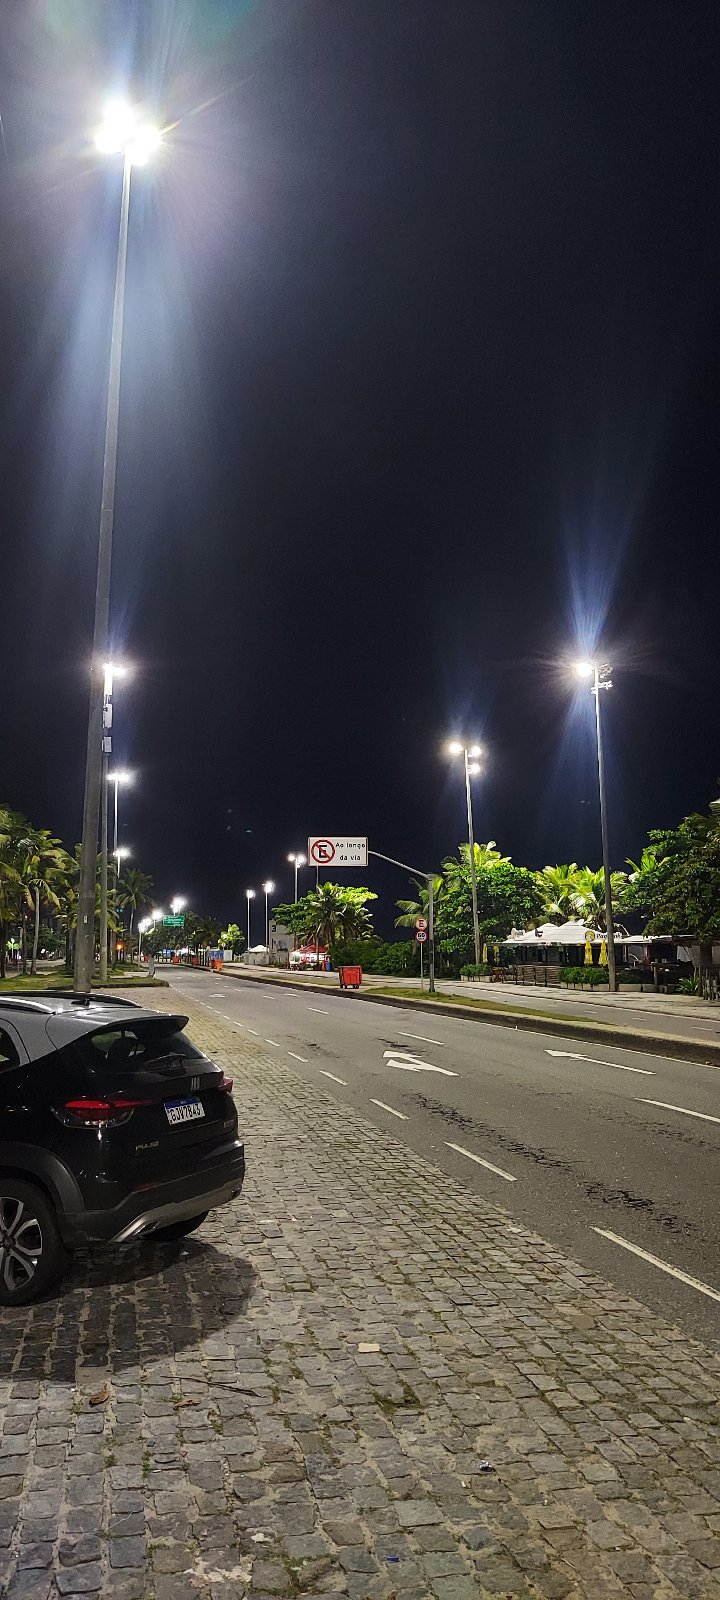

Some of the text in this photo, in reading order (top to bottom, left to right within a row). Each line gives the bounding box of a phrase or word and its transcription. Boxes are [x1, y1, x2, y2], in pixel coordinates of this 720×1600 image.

[346, 842, 366, 850] longo
[418, 919, 424, 928] E
[271, 924, 277, 933] 3
